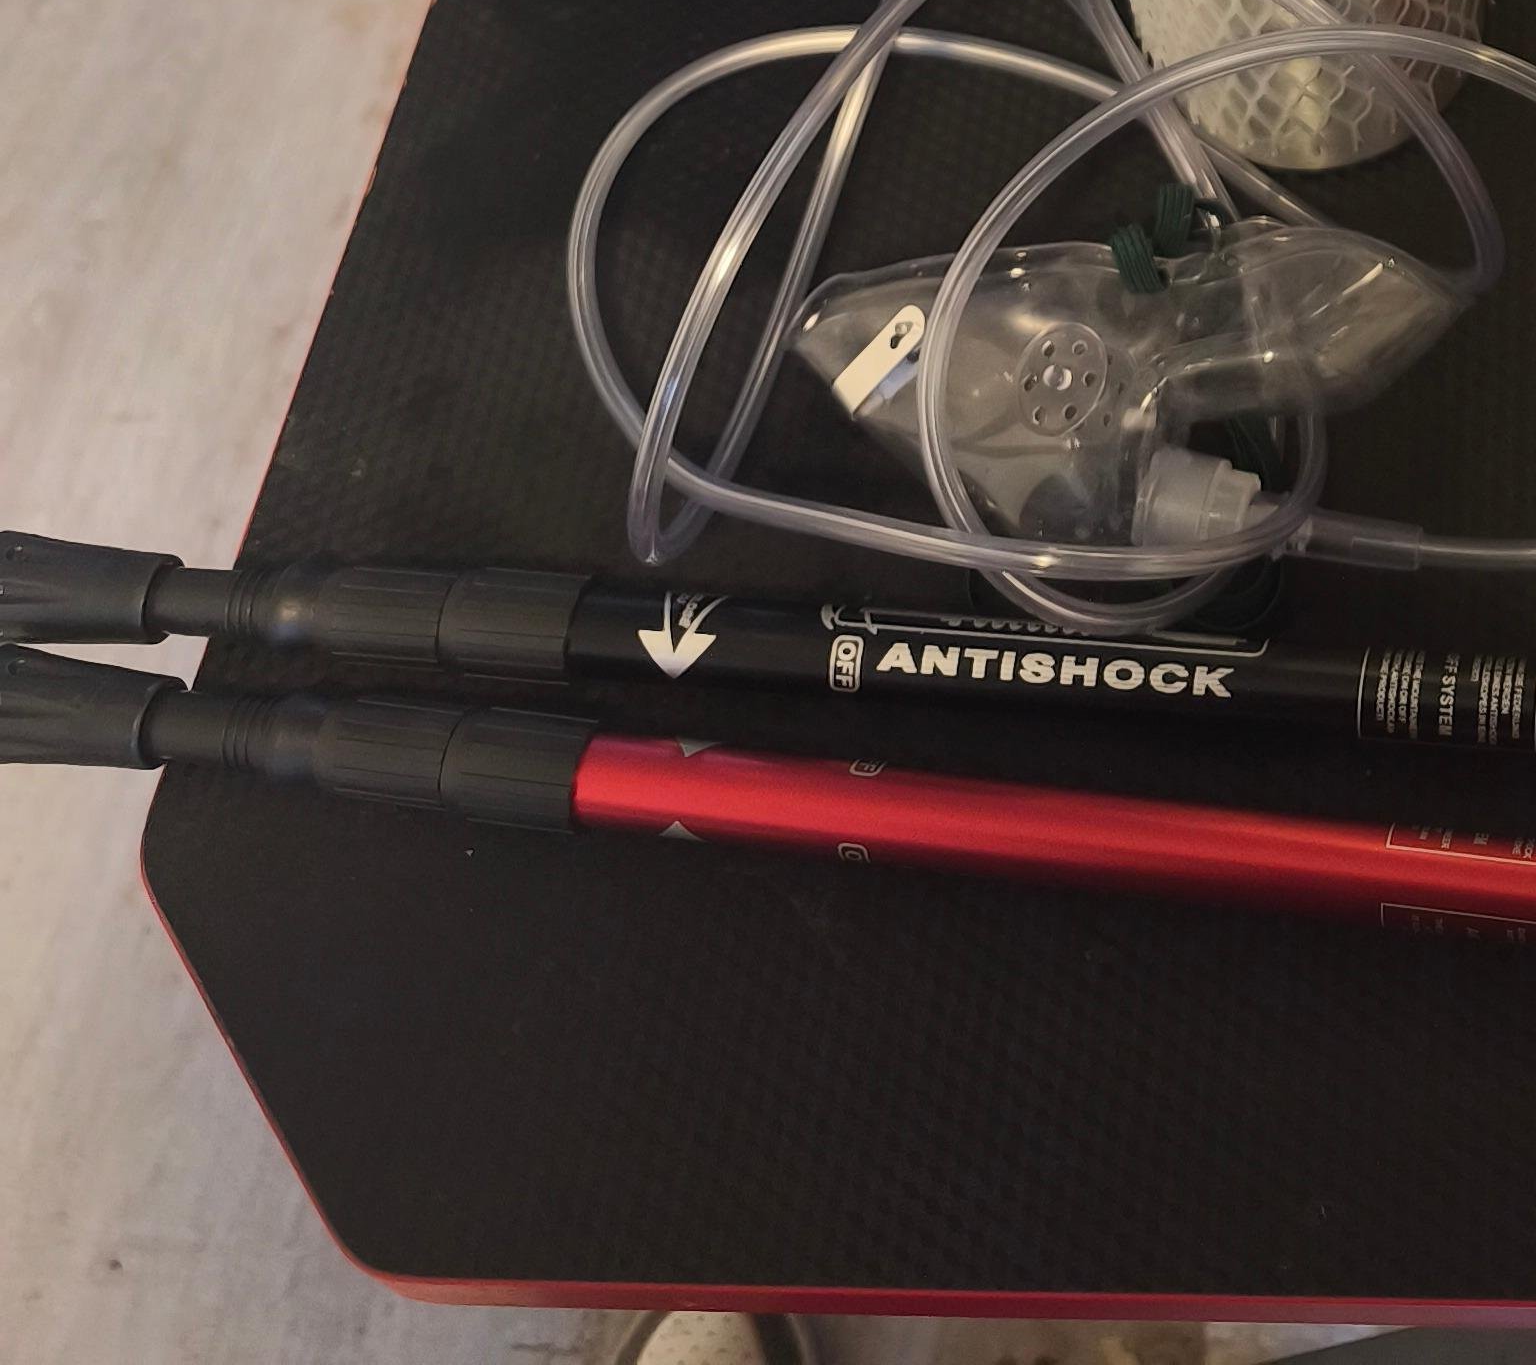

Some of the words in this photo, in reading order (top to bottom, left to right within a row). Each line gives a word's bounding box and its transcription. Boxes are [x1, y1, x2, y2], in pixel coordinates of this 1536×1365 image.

[836, 642, 855, 688] OFF
[875, 641, 1235, 698] ANTISHOCK
[1438, 674, 1457, 737] SYSTEM
